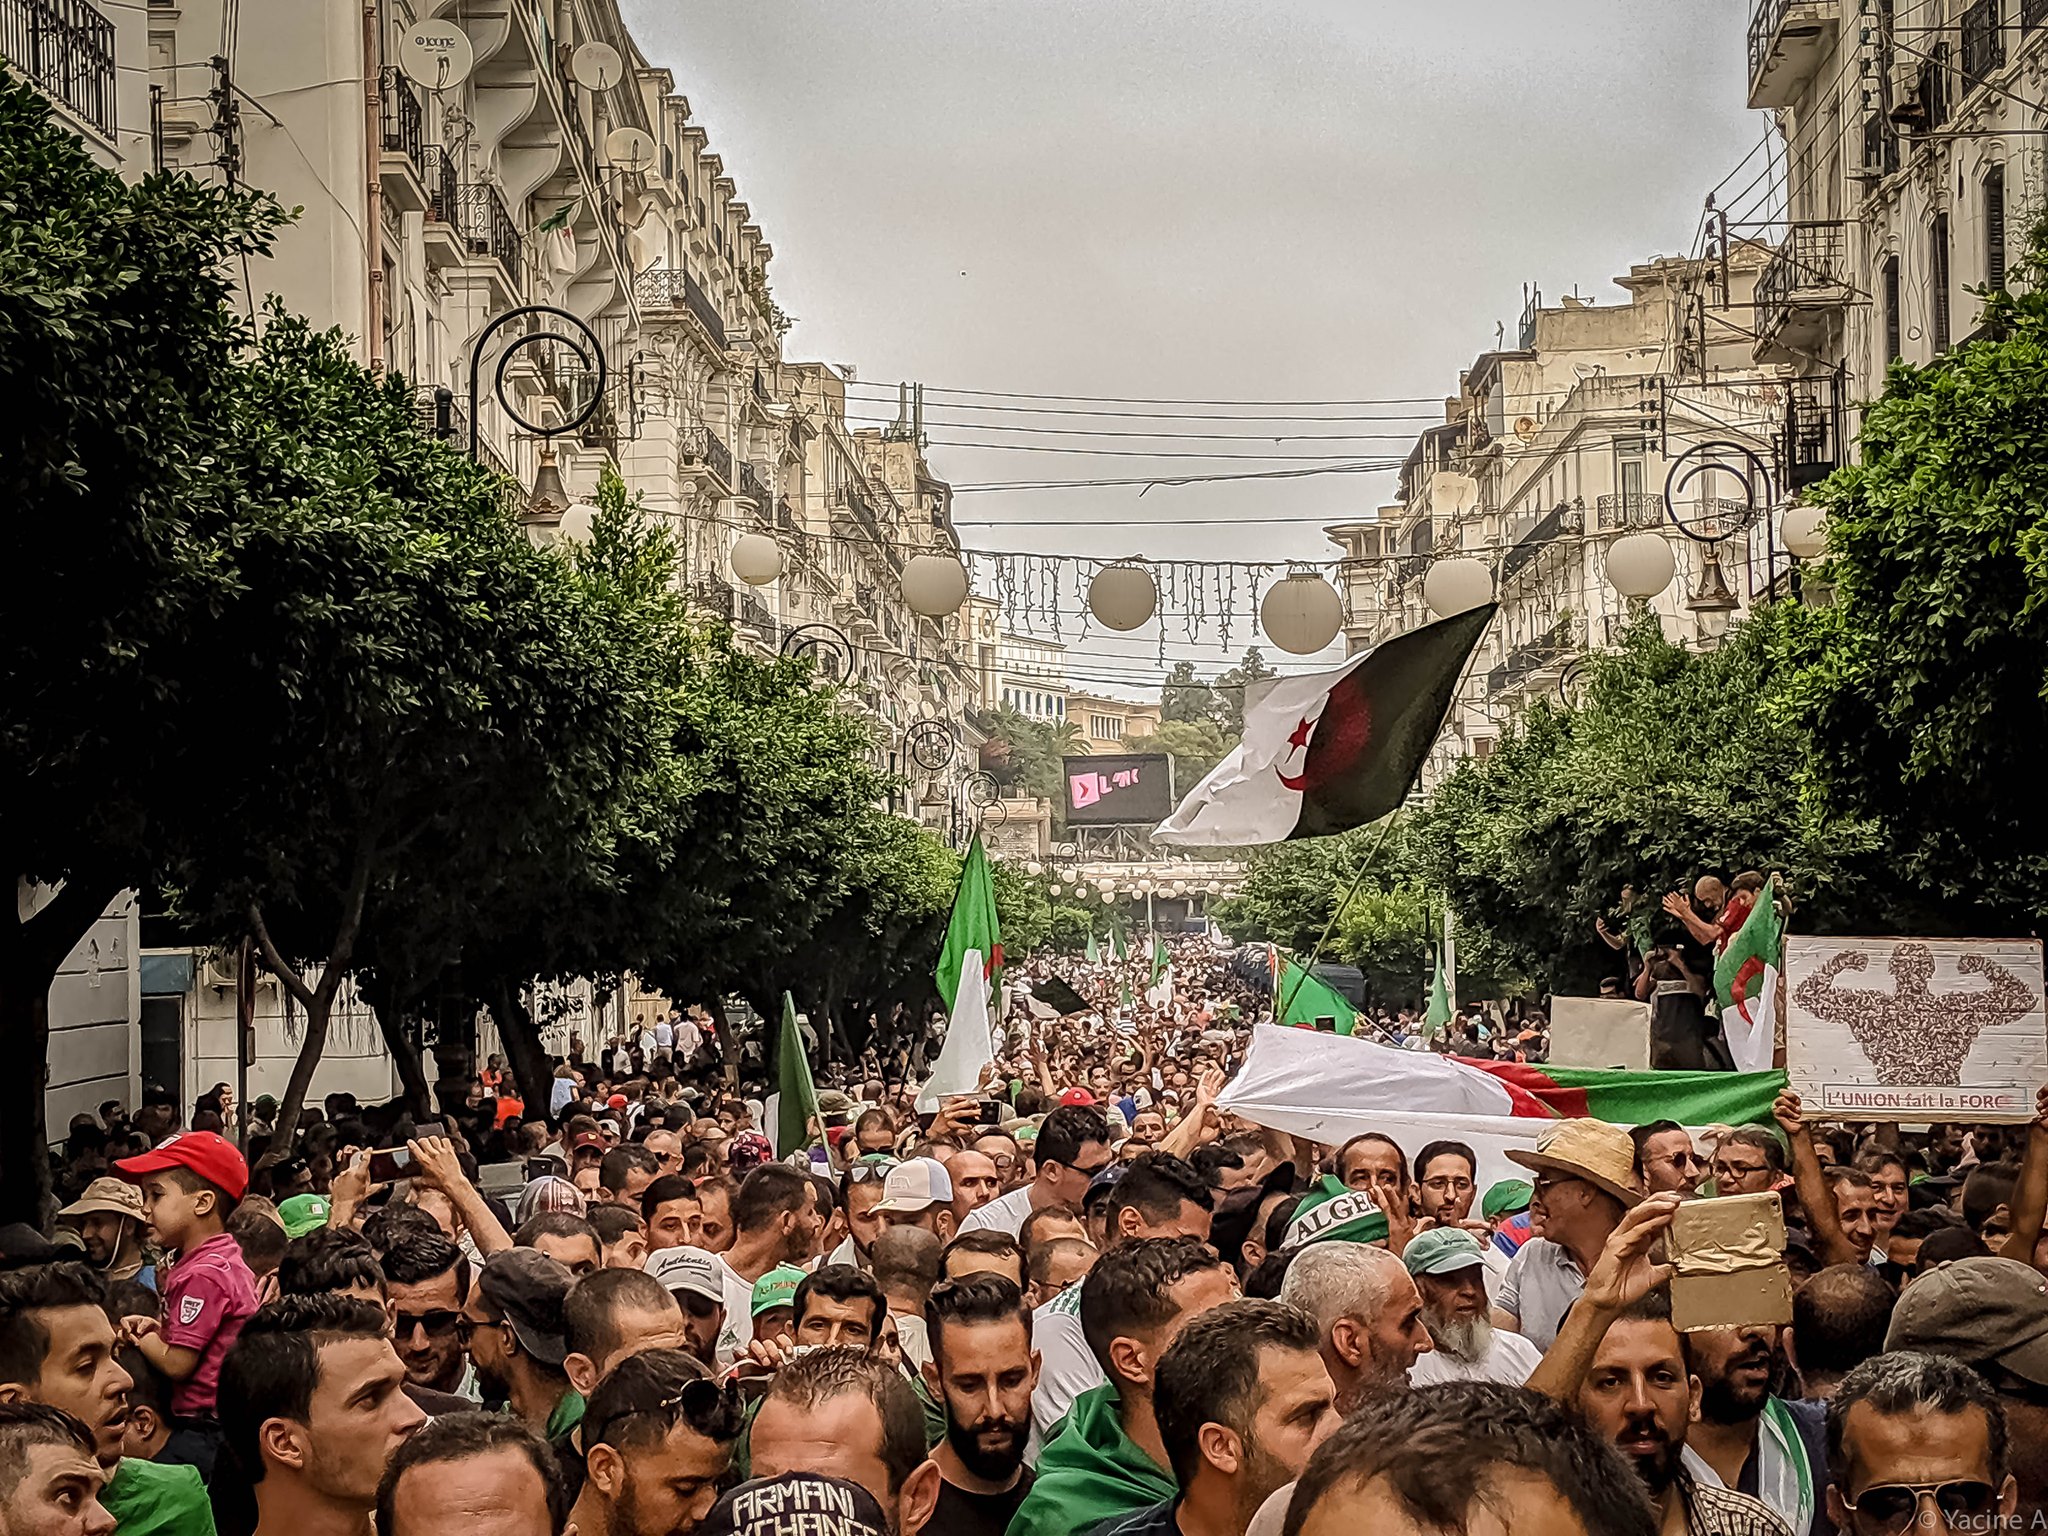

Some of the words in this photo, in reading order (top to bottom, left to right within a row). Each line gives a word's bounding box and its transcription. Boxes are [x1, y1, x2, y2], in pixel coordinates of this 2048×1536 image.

[1827, 1091, 1900, 1107] L'UNION
[1904, 1092, 1935, 1108] fait
[1939, 1092, 1955, 1108] la
[1959, 1094, 2014, 1109] FORC
[732, 1479, 855, 1527] ARMANI
